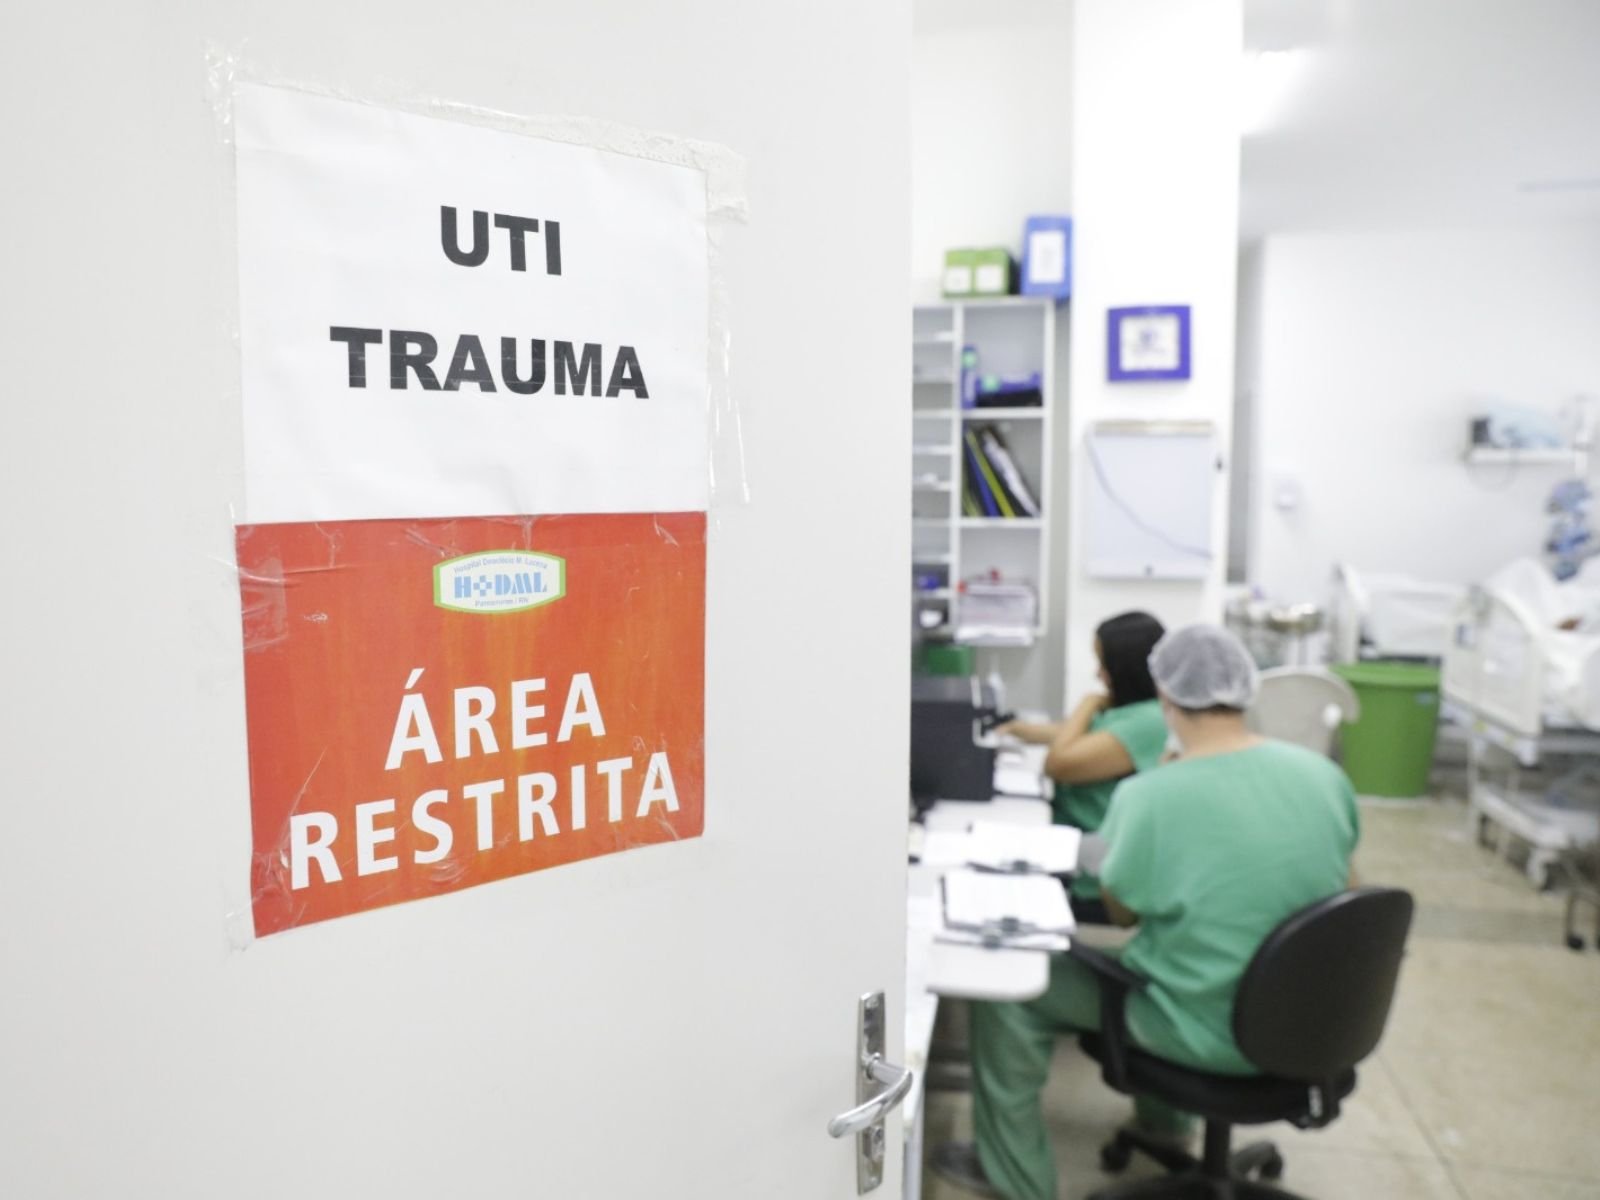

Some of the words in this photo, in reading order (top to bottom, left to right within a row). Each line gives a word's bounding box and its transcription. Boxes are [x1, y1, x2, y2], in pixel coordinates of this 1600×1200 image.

[442, 206, 562, 276] UTI
[330, 326, 649, 399] TRAUMA
[385, 667, 606, 771] ÁREA
[290, 751, 680, 890] RESTRITA
